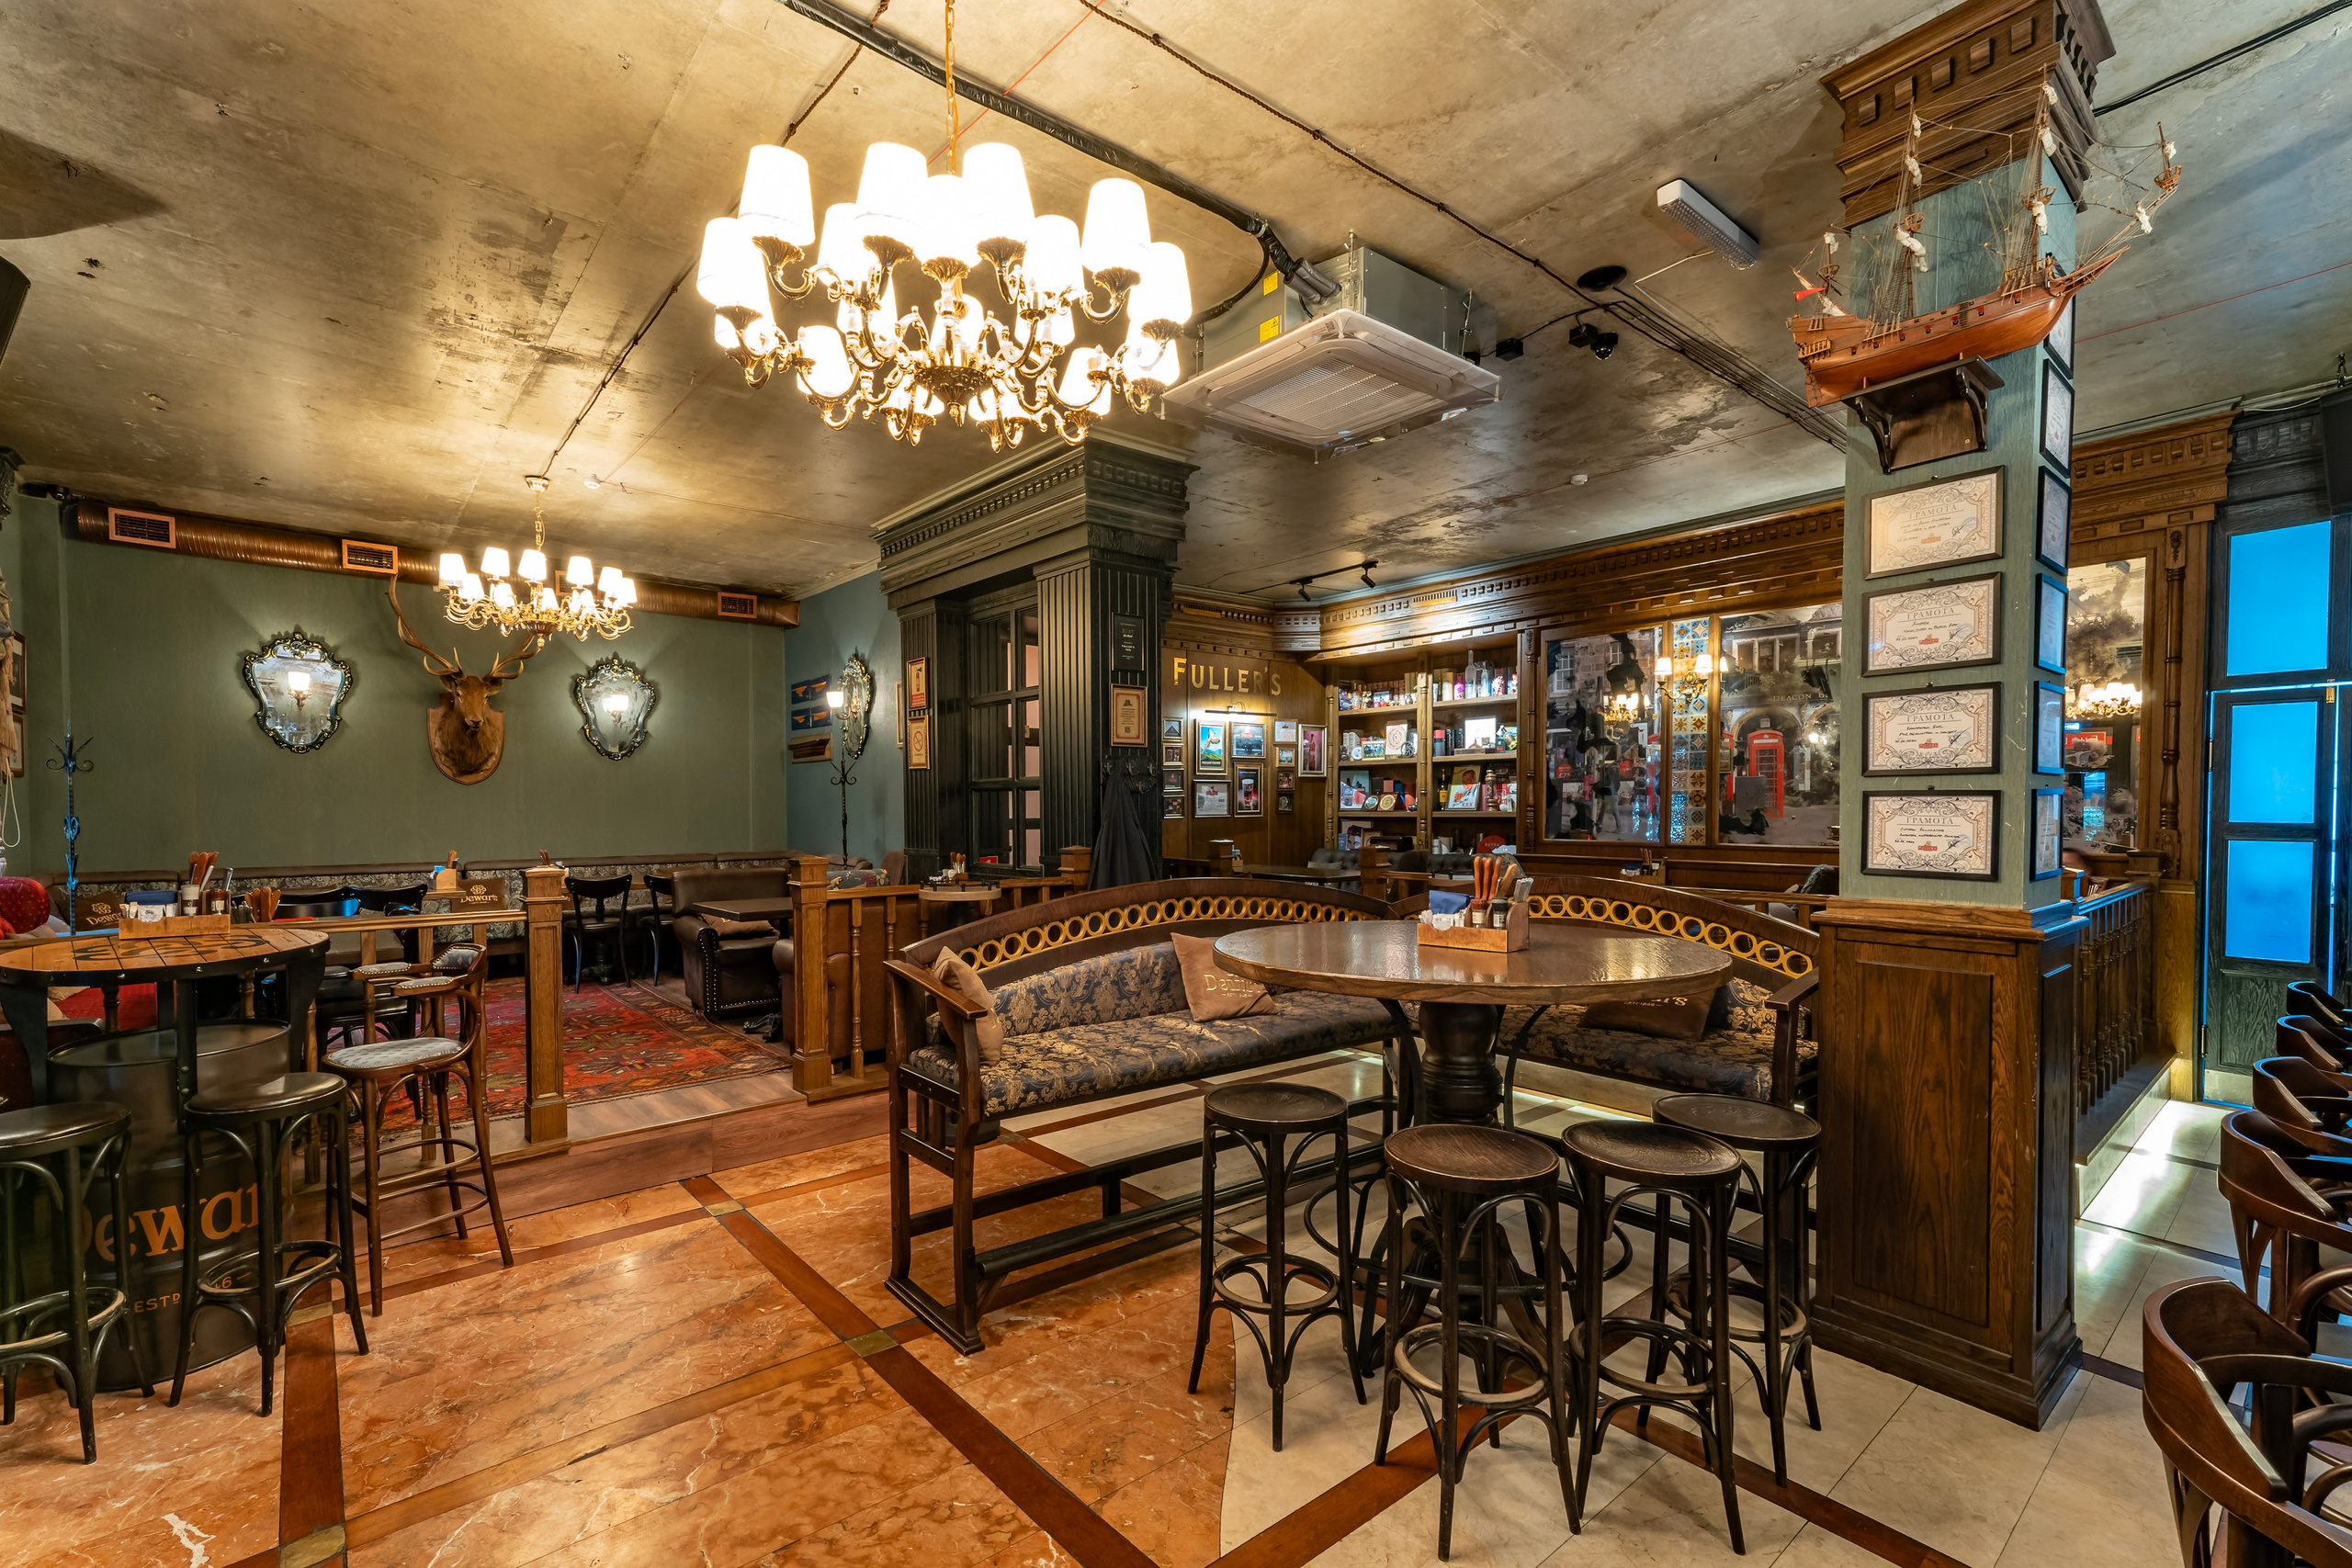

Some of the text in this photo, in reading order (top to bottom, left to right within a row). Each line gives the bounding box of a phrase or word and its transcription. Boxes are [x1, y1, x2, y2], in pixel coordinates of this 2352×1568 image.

[1908, 504, 1958, 519] ГРАМОТА
[1906, 607, 1955, 620] ГРАМОТА
[1173, 657, 1283, 696] FULLER'S
[1772, 693, 1813, 702] DEACON
[1906, 713, 1955, 723] ГРАМОТА
[1906, 817, 1954, 825] ГРАМОТА
